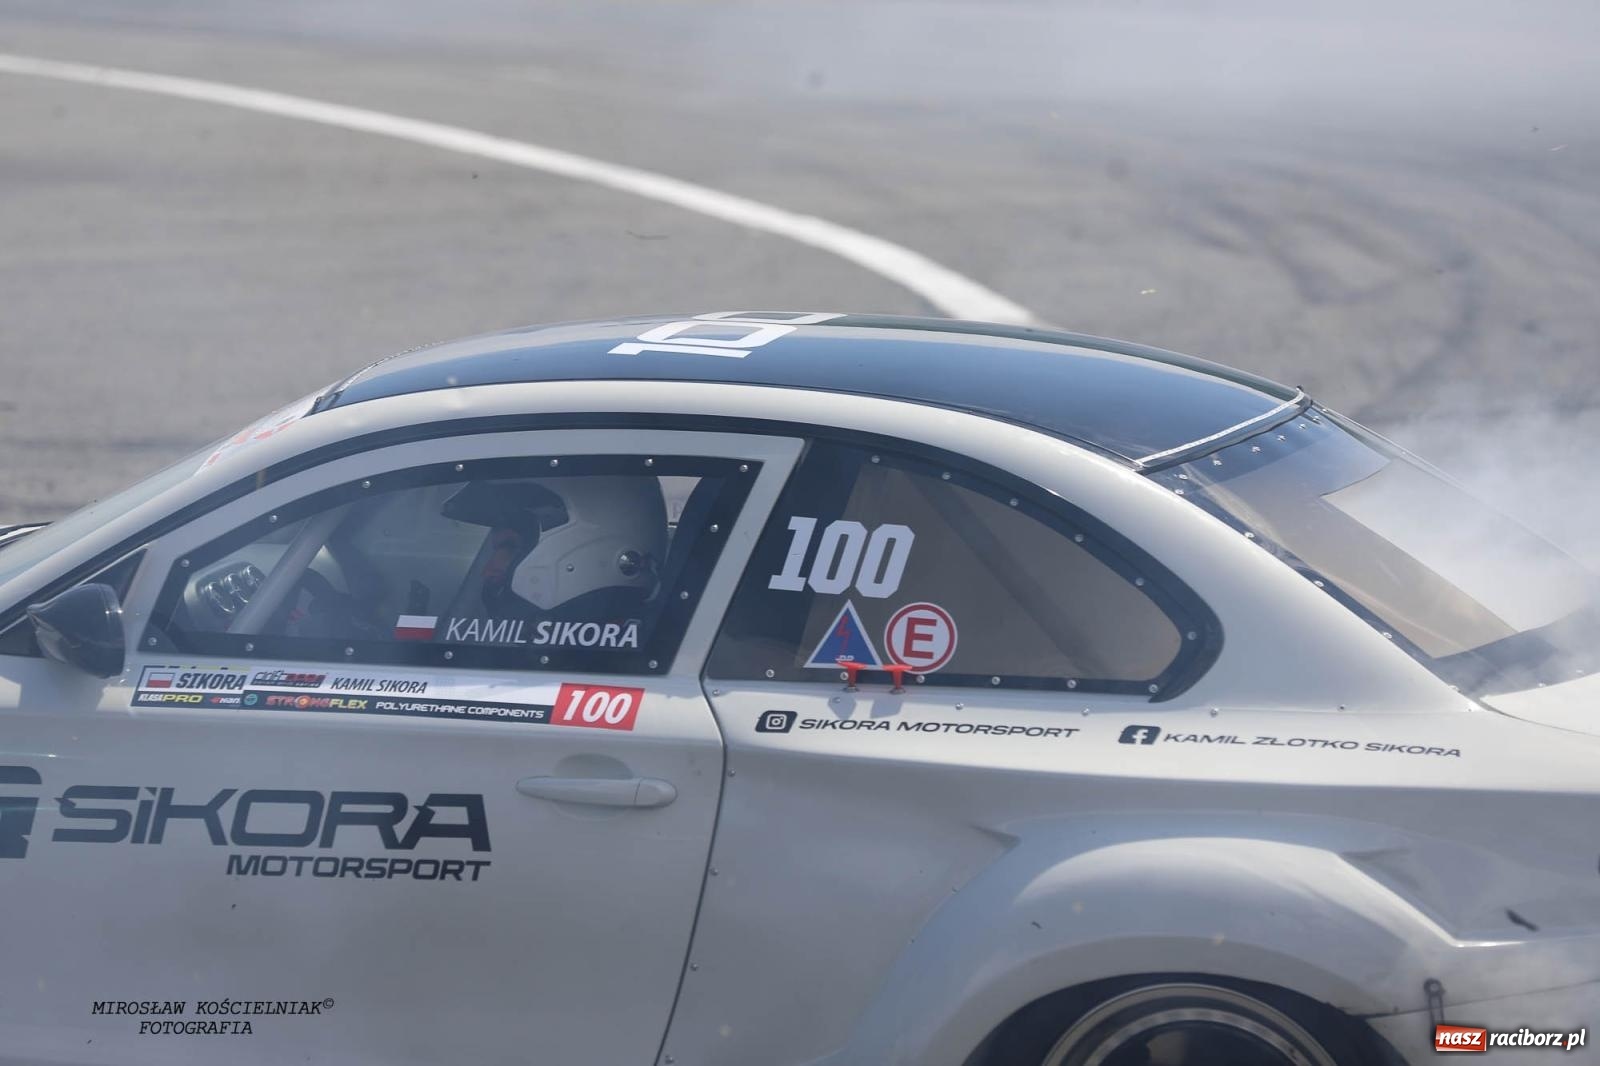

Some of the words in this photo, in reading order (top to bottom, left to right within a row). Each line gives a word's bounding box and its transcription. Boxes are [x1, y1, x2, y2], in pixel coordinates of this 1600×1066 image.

[607, 311, 848, 358] 100
[767, 516, 915, 598] 100
[446, 617, 527, 644] KAMIL
[533, 620, 638, 648] SIKORA
[903, 617, 937, 659] E
[176, 673, 247, 690] SIKORA
[330, 677, 377, 692] KAMIL
[377, 680, 428, 694] SIKORA
[375, 701, 465, 715] POLYURETHANE
[468, 706, 545, 719] COMPONENTS
[563, 690, 632, 724] 100
[799, 718, 890, 731] SIKORA
[897, 721, 1080, 738] MOTORSPORT
[1164, 733, 1246, 745] KAMIL
[1252, 736, 1359, 750] ZŁOTKO
[1364, 742, 1462, 758] SIKORA
[226, 854, 492, 881] MOTORSPORT
